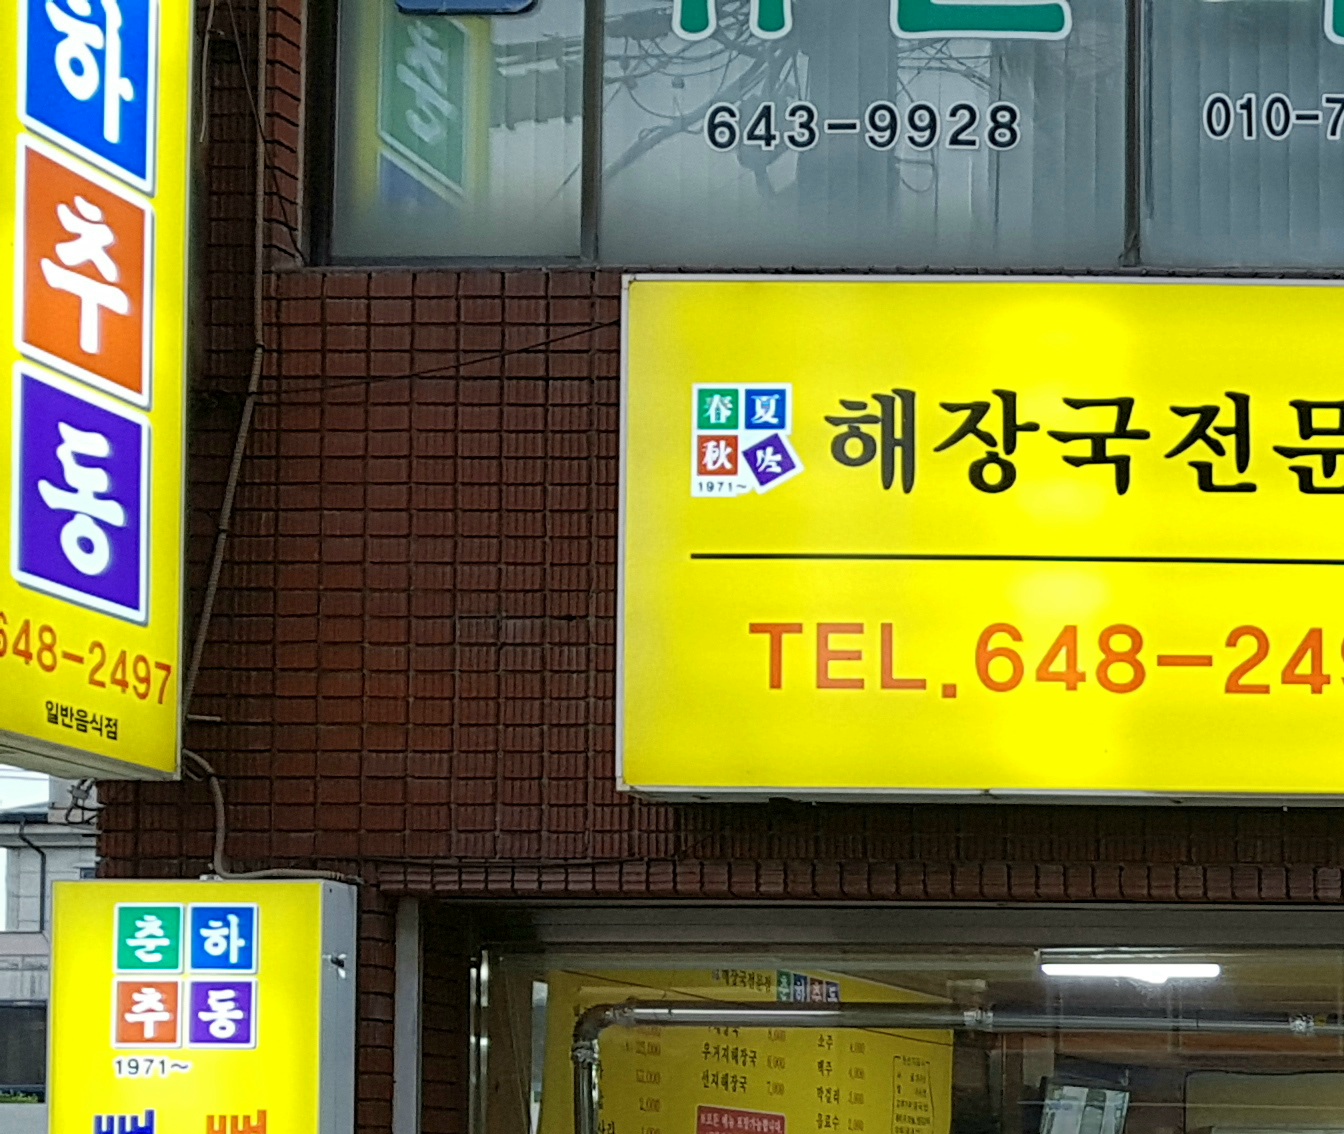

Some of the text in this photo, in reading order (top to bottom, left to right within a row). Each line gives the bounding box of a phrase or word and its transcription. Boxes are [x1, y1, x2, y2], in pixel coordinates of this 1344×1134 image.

[704, 101, 1021, 151] 643-9928
[45, 699, 119, 742] 일반음식점
[114, 1058, 190, 1077] 1971~
